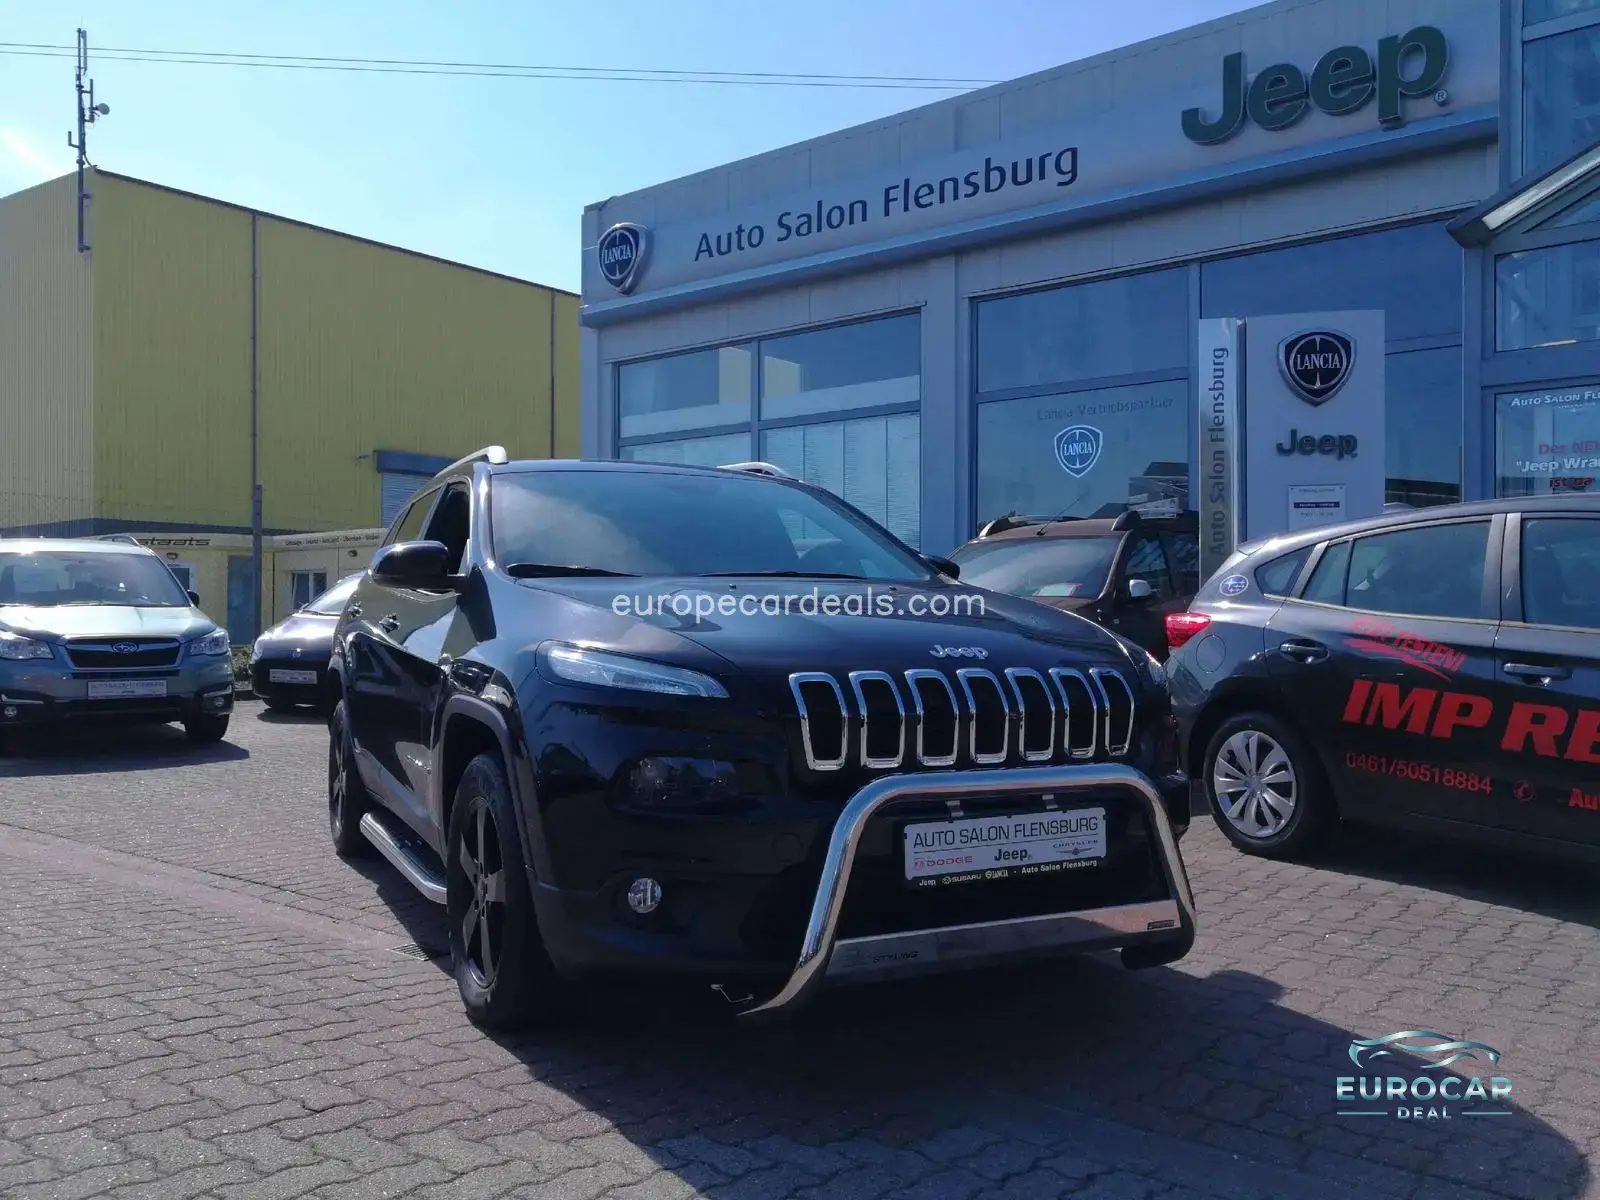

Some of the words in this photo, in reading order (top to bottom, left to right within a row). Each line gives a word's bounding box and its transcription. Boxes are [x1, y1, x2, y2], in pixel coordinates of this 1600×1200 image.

[1181, 26, 1448, 145] Jeep
[694, 224, 765, 262] Auto
[776, 199, 867, 242] Salon
[884, 146, 1078, 217] Flensburg
[604, 244, 632, 264] LANCIA
[1296, 353, 1341, 370] LANCIA
[1208, 347, 1229, 443] Flensburg
[1063, 442, 1093, 456] LANCIA
[1276, 428, 1358, 461] Jeep
[1209, 450, 1226, 504] Salon
[1563, 456, 1600, 469] Wra
[1210, 510, 1226, 554] Auto
[930, 644, 989, 659] Jeep
[1343, 679, 1493, 739] IMP
[1345, 751, 1493, 795] 0461/50518884
[1568, 787, 1600, 811] Au
[913, 830, 955, 849] AUTO
[959, 825, 1010, 844] SALON
[1014, 816, 1099, 838] FLENSBURG
[926, 855, 973, 868] DODGE
[994, 848, 1028, 863] Jeep
[919, 878, 937, 887] Jeep
[951, 873, 982, 883] SUBARU
[1021, 866, 1039, 875] Auto
[1040, 864, 1060, 873] Salon
[1062, 859, 1098, 871] Flensburg
